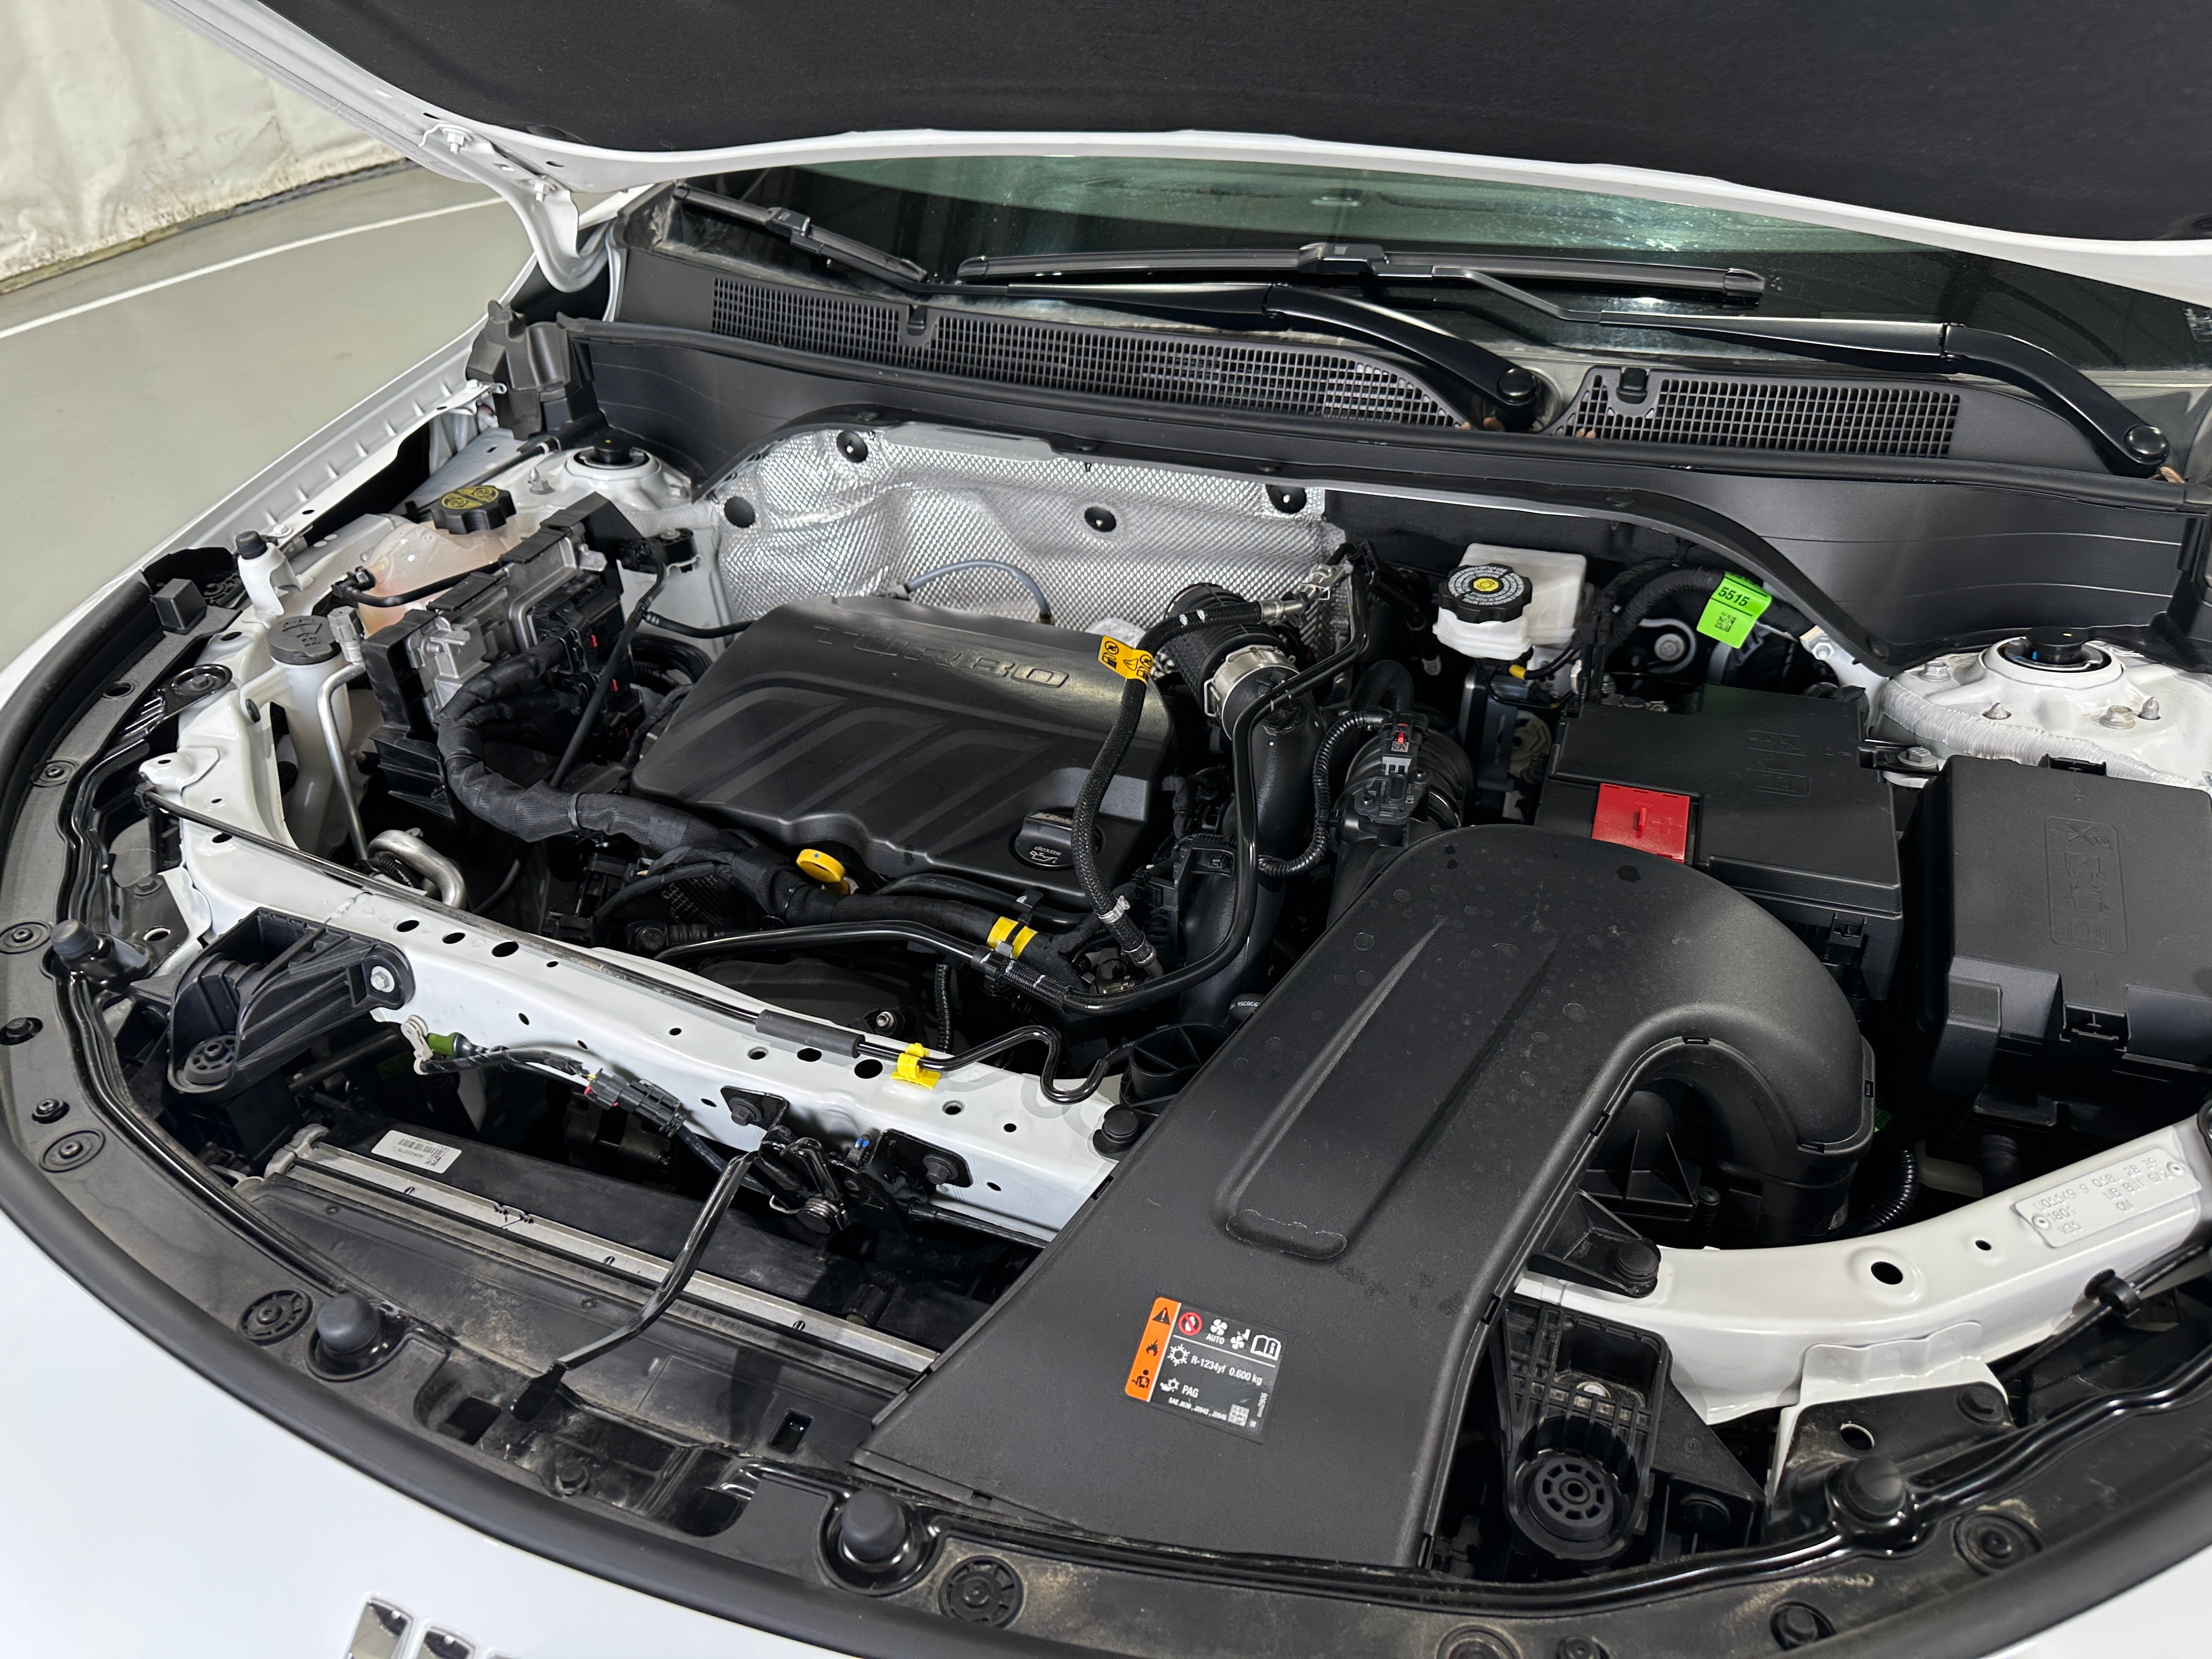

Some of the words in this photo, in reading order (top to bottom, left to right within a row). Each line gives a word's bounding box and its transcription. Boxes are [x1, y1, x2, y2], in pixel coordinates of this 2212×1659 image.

[1718, 586, 1750, 607] 5515
[814, 625, 1069, 688] TURBO
[1034, 845, 1063, 856] dexos
[2123, 1164, 2142, 1178] 28
[2047, 1206, 2077, 1221] 1801
[2056, 1220, 2081, 1235] V35
[1206, 1334, 1225, 1345] AUTO
[1190, 1355, 1226, 1374] R-1234yf
[1229, 1367, 1252, 1382] 0.600
[1252, 1373, 1263, 1386] kg
[1181, 1385, 1199, 1398] PAG
